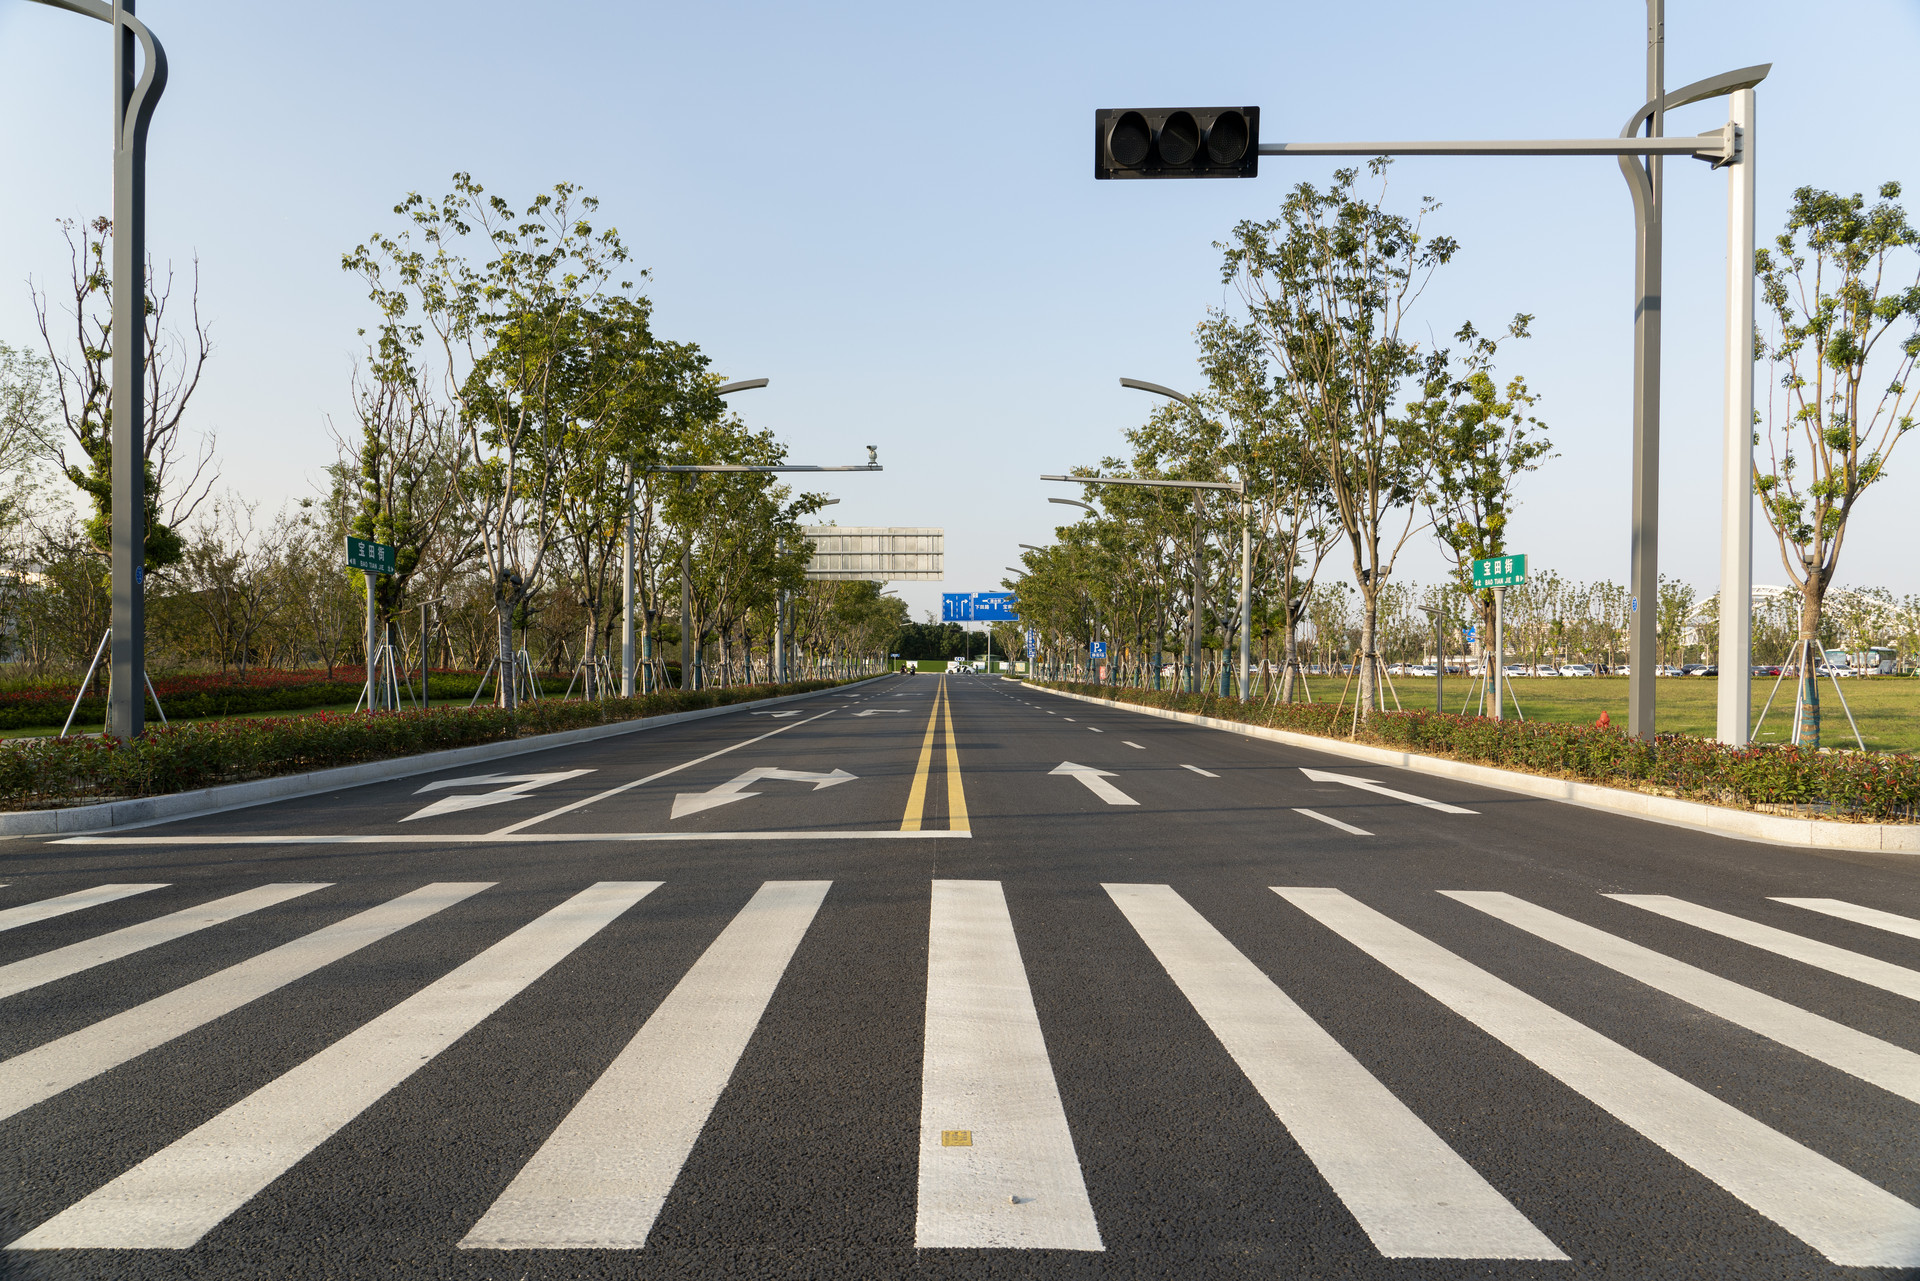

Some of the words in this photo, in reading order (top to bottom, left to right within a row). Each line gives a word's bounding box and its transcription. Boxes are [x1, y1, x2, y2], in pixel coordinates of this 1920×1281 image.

[358, 542, 385, 561] 宝田街
[1484, 559, 1513, 576] 宝田街
[1504, 576, 1512, 584] JIE
[1094, 642, 1100, 652] P
